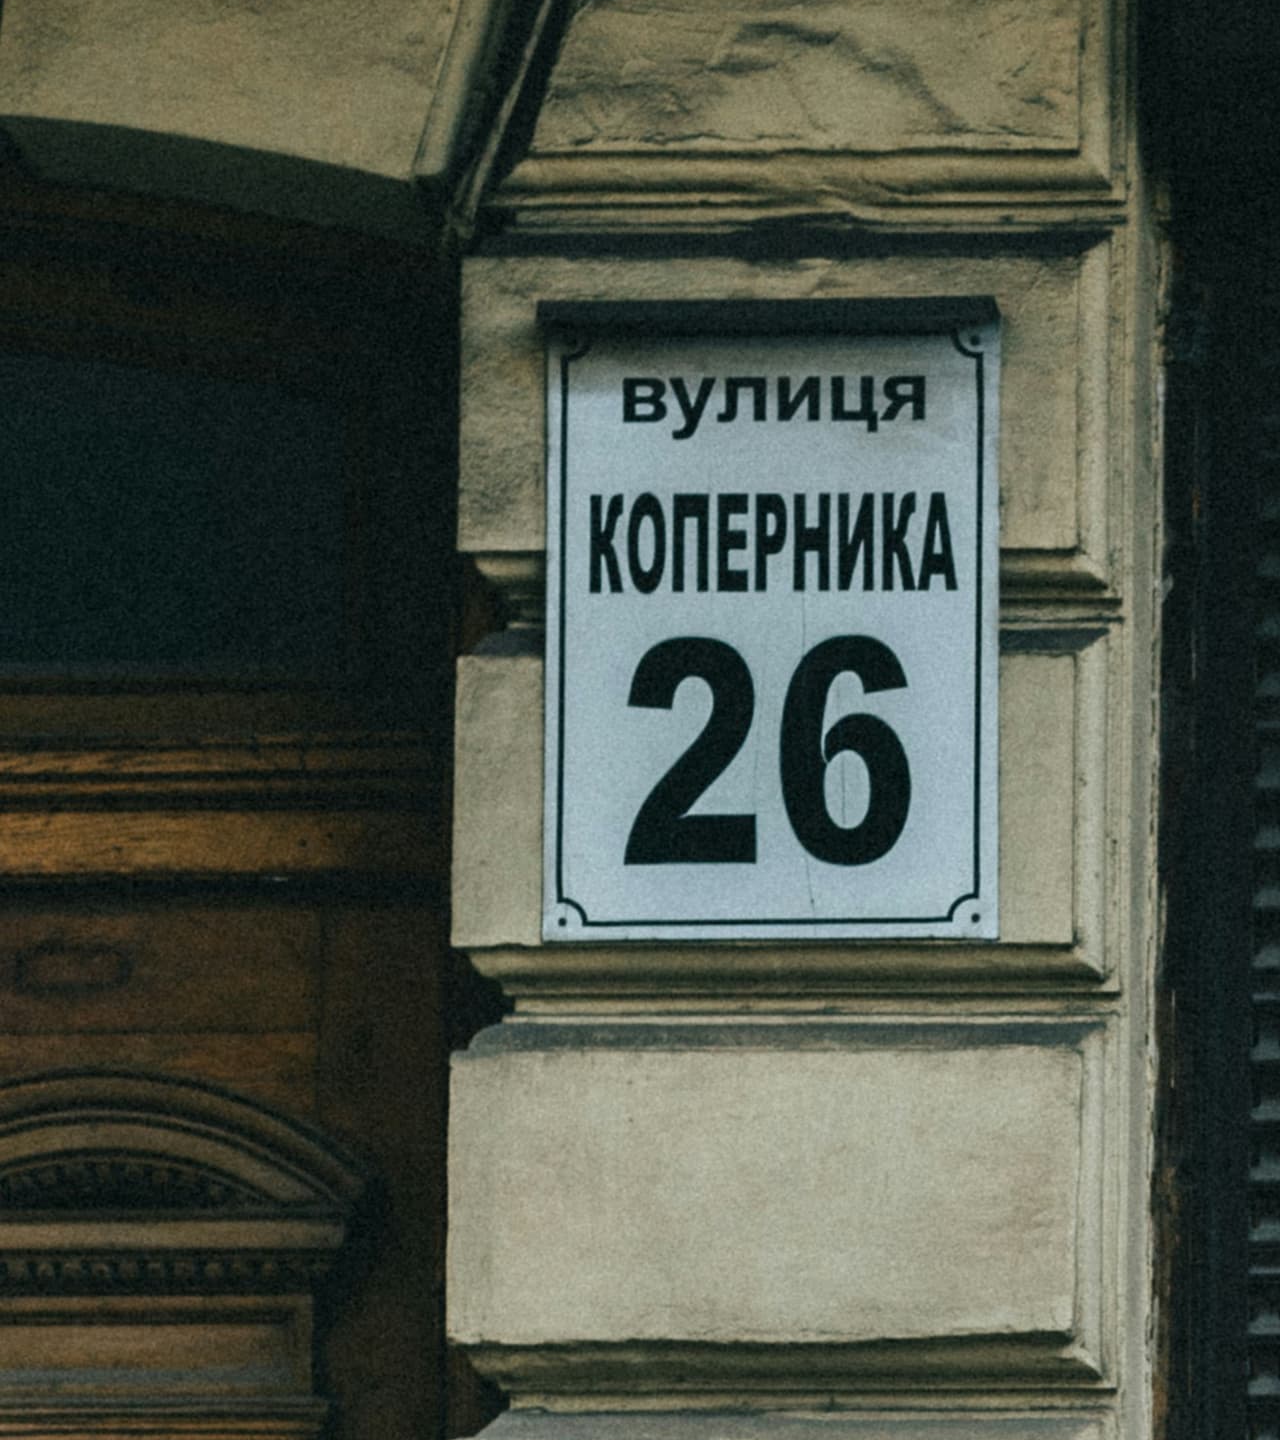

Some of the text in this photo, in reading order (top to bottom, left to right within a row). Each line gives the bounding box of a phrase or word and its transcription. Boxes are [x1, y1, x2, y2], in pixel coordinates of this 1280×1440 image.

[622, 375, 927, 440] вулиця
[589, 491, 959, 595] КОПЕРНИКА
[623, 633, 912, 867] 26
